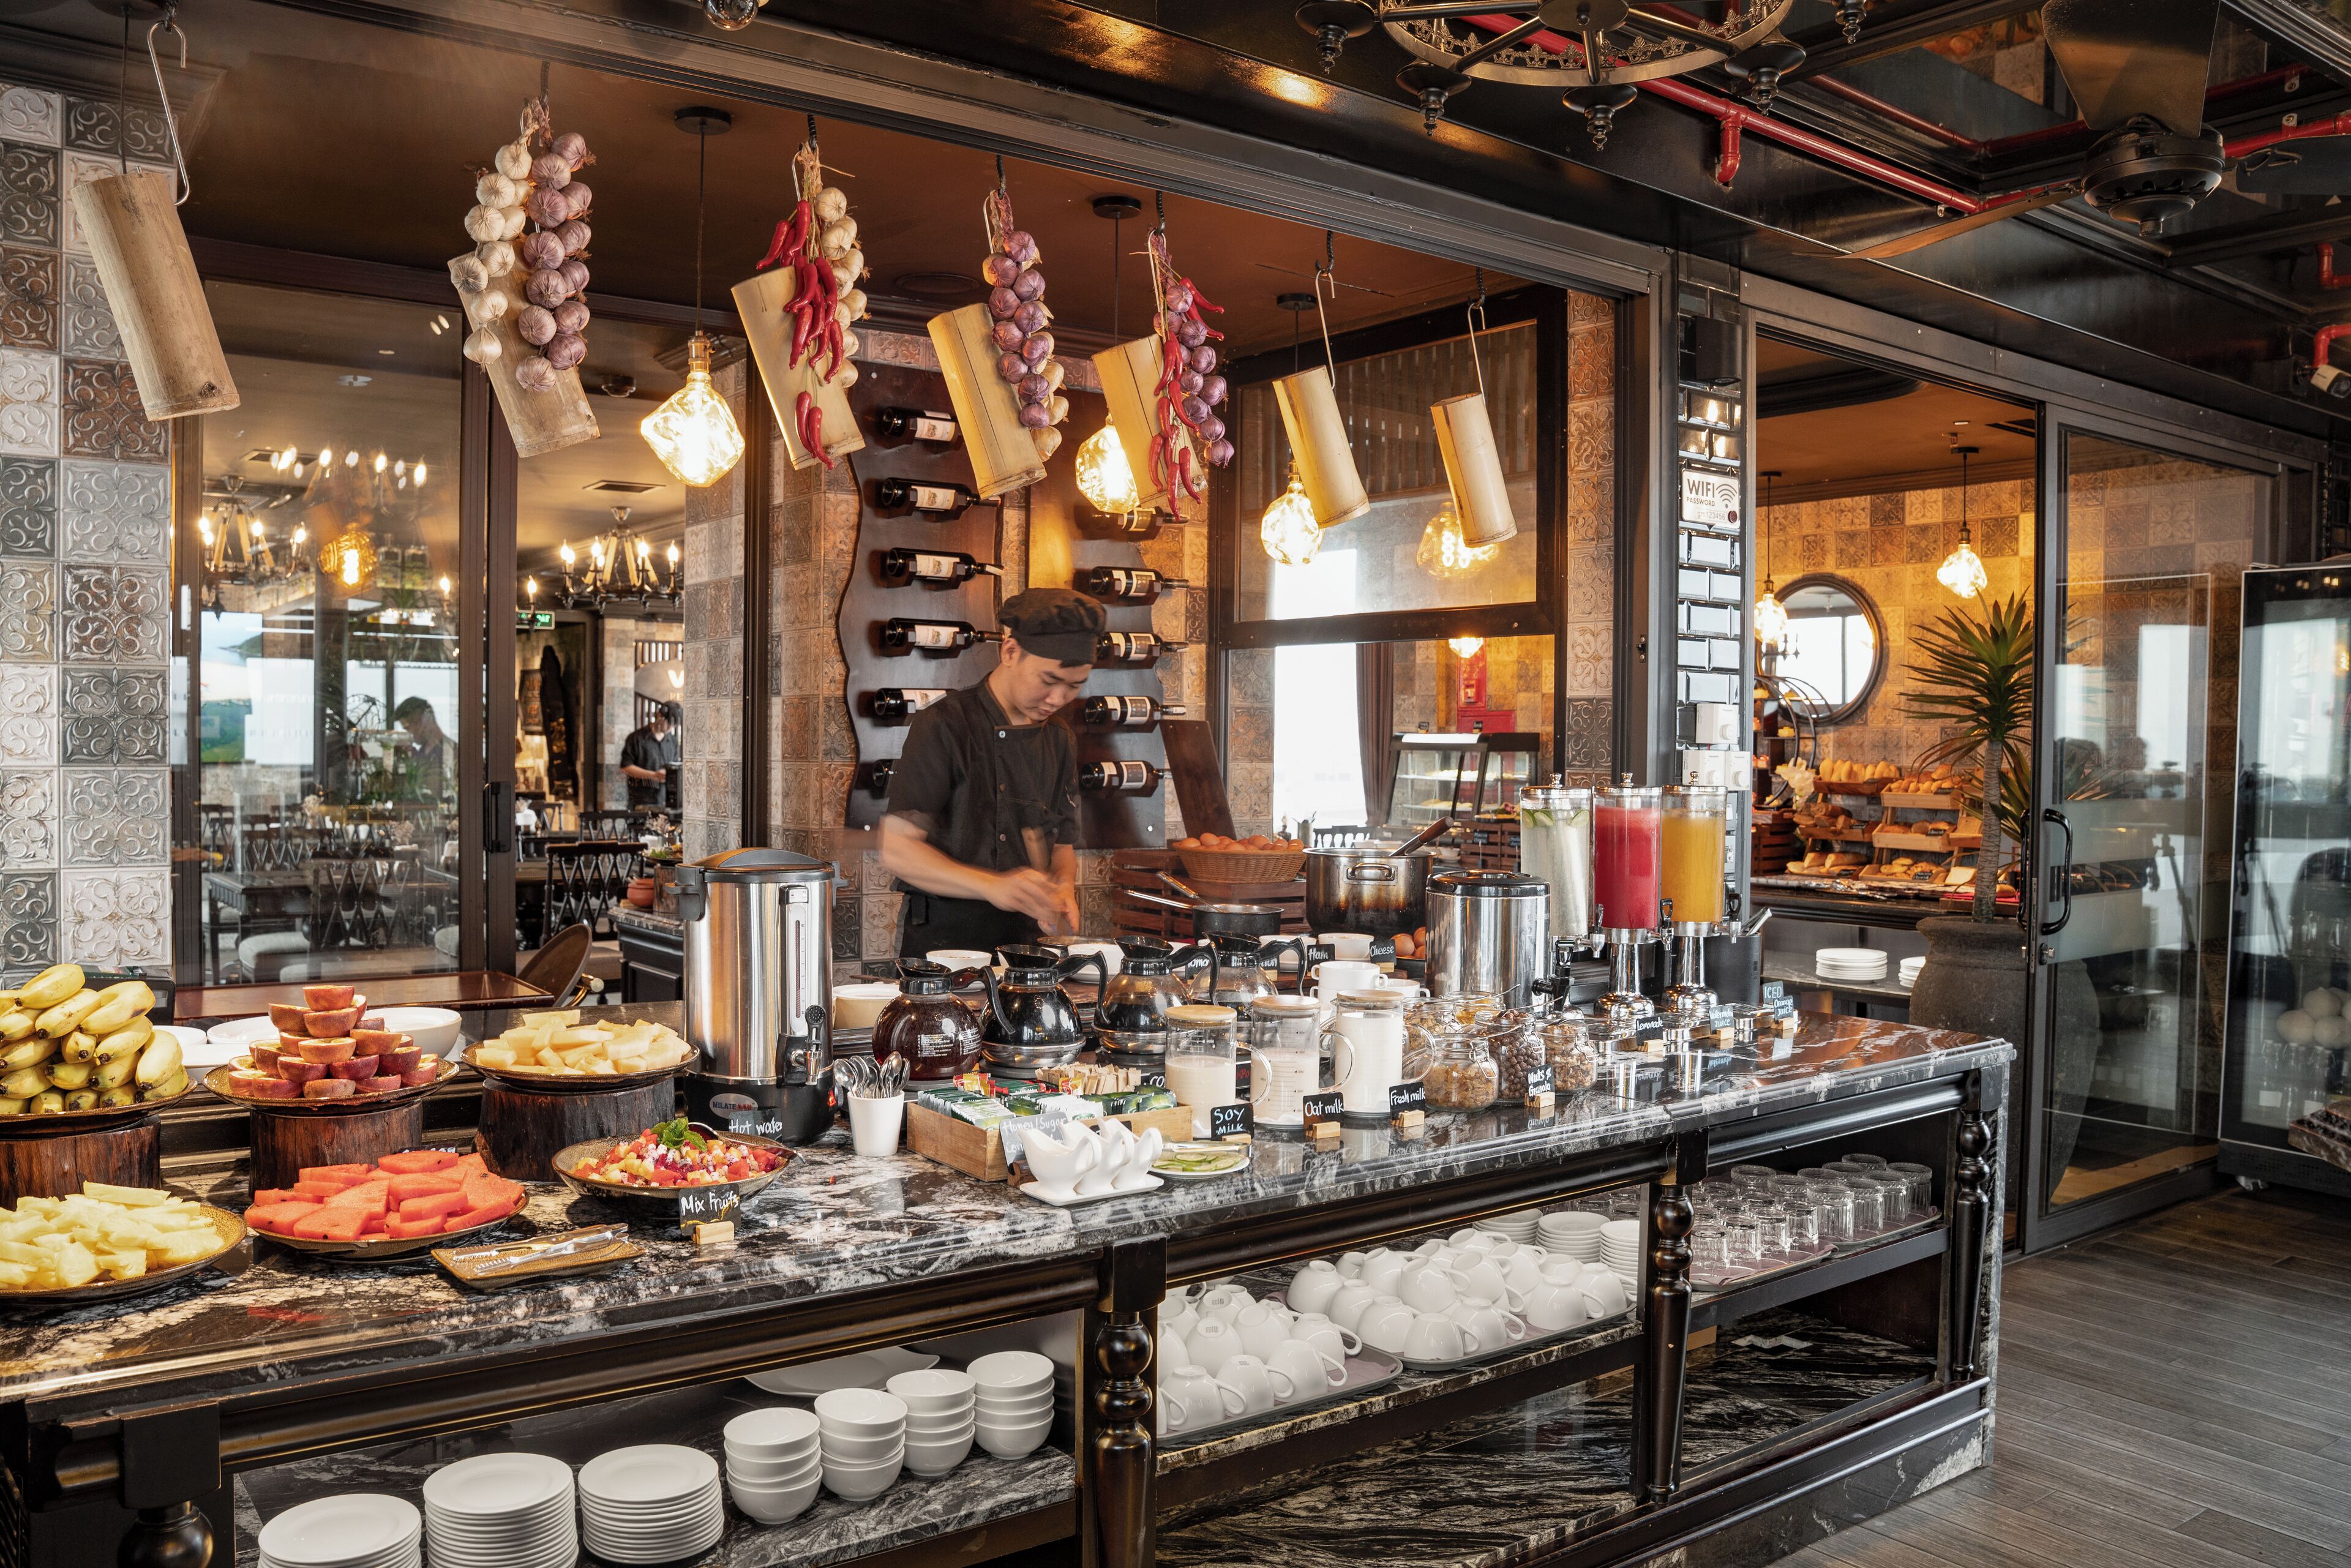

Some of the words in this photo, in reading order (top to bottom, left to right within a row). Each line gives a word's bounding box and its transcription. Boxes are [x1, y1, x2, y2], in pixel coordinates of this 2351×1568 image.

[1687, 479, 1715, 498] WIFI
[1687, 497, 1715, 506] PASSWORD
[1308, 947, 1329, 961] Ham
[1370, 944, 1395, 957] Cheese
[1764, 986, 1782, 999] ICED
[1774, 999, 1793, 1008] Orange
[1637, 1016, 1664, 1032] Lemonade
[1528, 1070, 1545, 1085] Nuts
[1390, 1090, 1409, 1106] Fresh
[1410, 1087, 1426, 1102] milk
[1528, 1080, 1551, 1098] Granola
[1305, 1100, 1324, 1117] Oat
[1324, 1098, 1345, 1114] milk
[1214, 1107, 1245, 1125] SOY
[728, 1119, 752, 1135] Hot
[681, 1195, 705, 1217] Mix
[709, 1190, 740, 1212] Fruits
